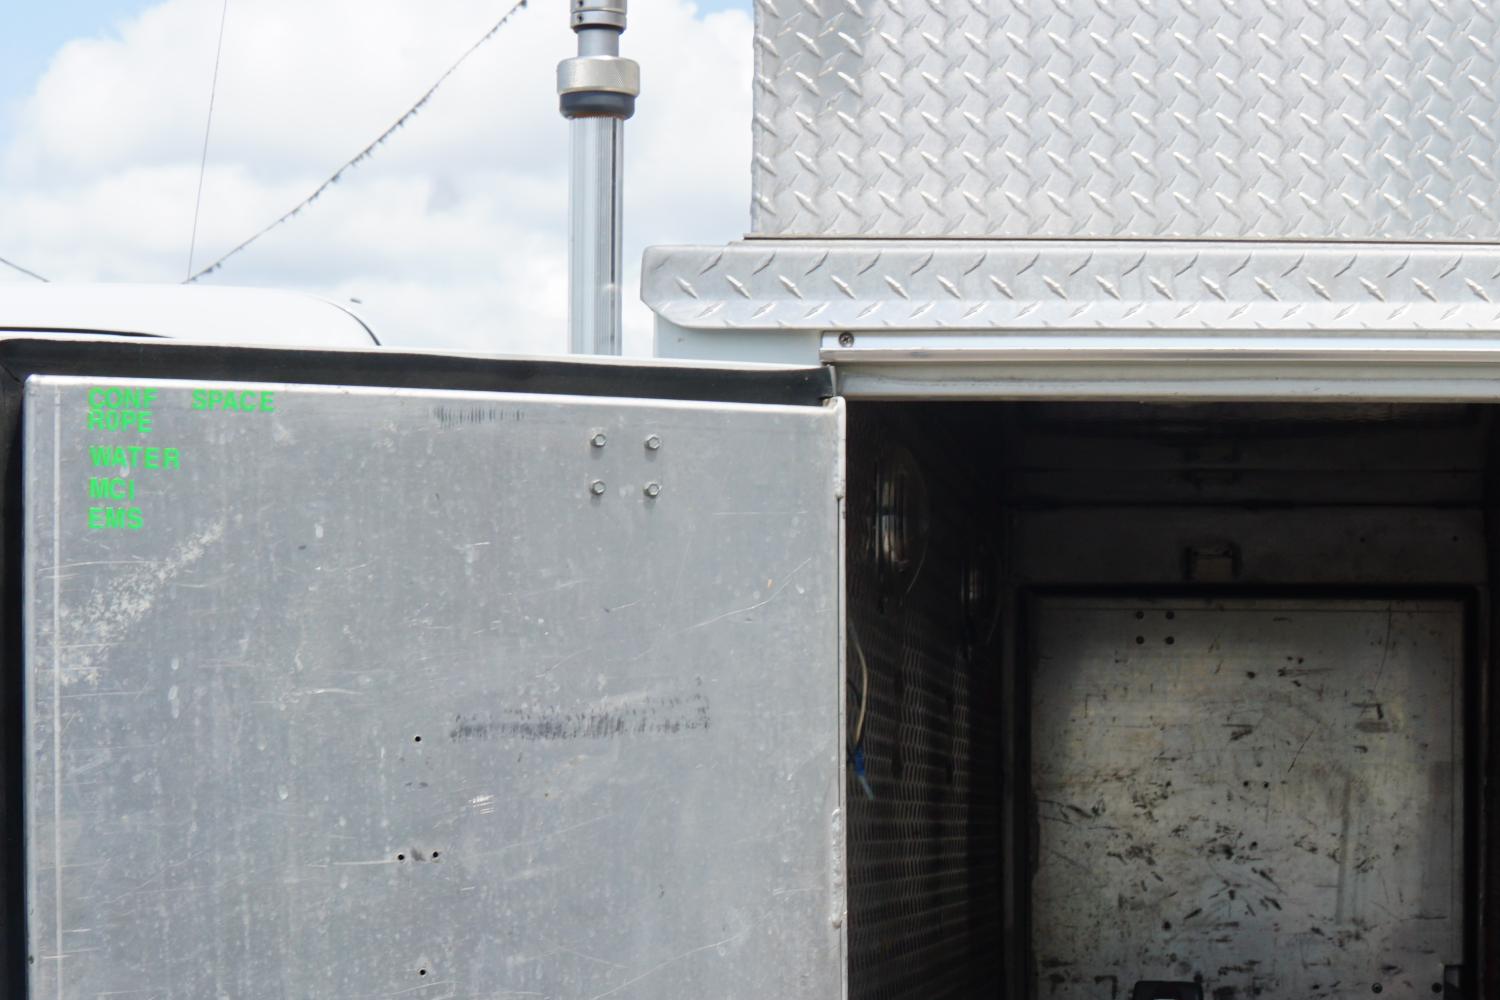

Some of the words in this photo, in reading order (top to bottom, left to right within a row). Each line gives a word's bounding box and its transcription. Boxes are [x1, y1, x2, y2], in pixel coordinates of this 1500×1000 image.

[88, 387, 159, 409] CONF
[191, 389, 275, 412] SPACE
[89, 445, 181, 470] WATER
[89, 477, 135, 501] MCI
[87, 507, 144, 530] EMS
